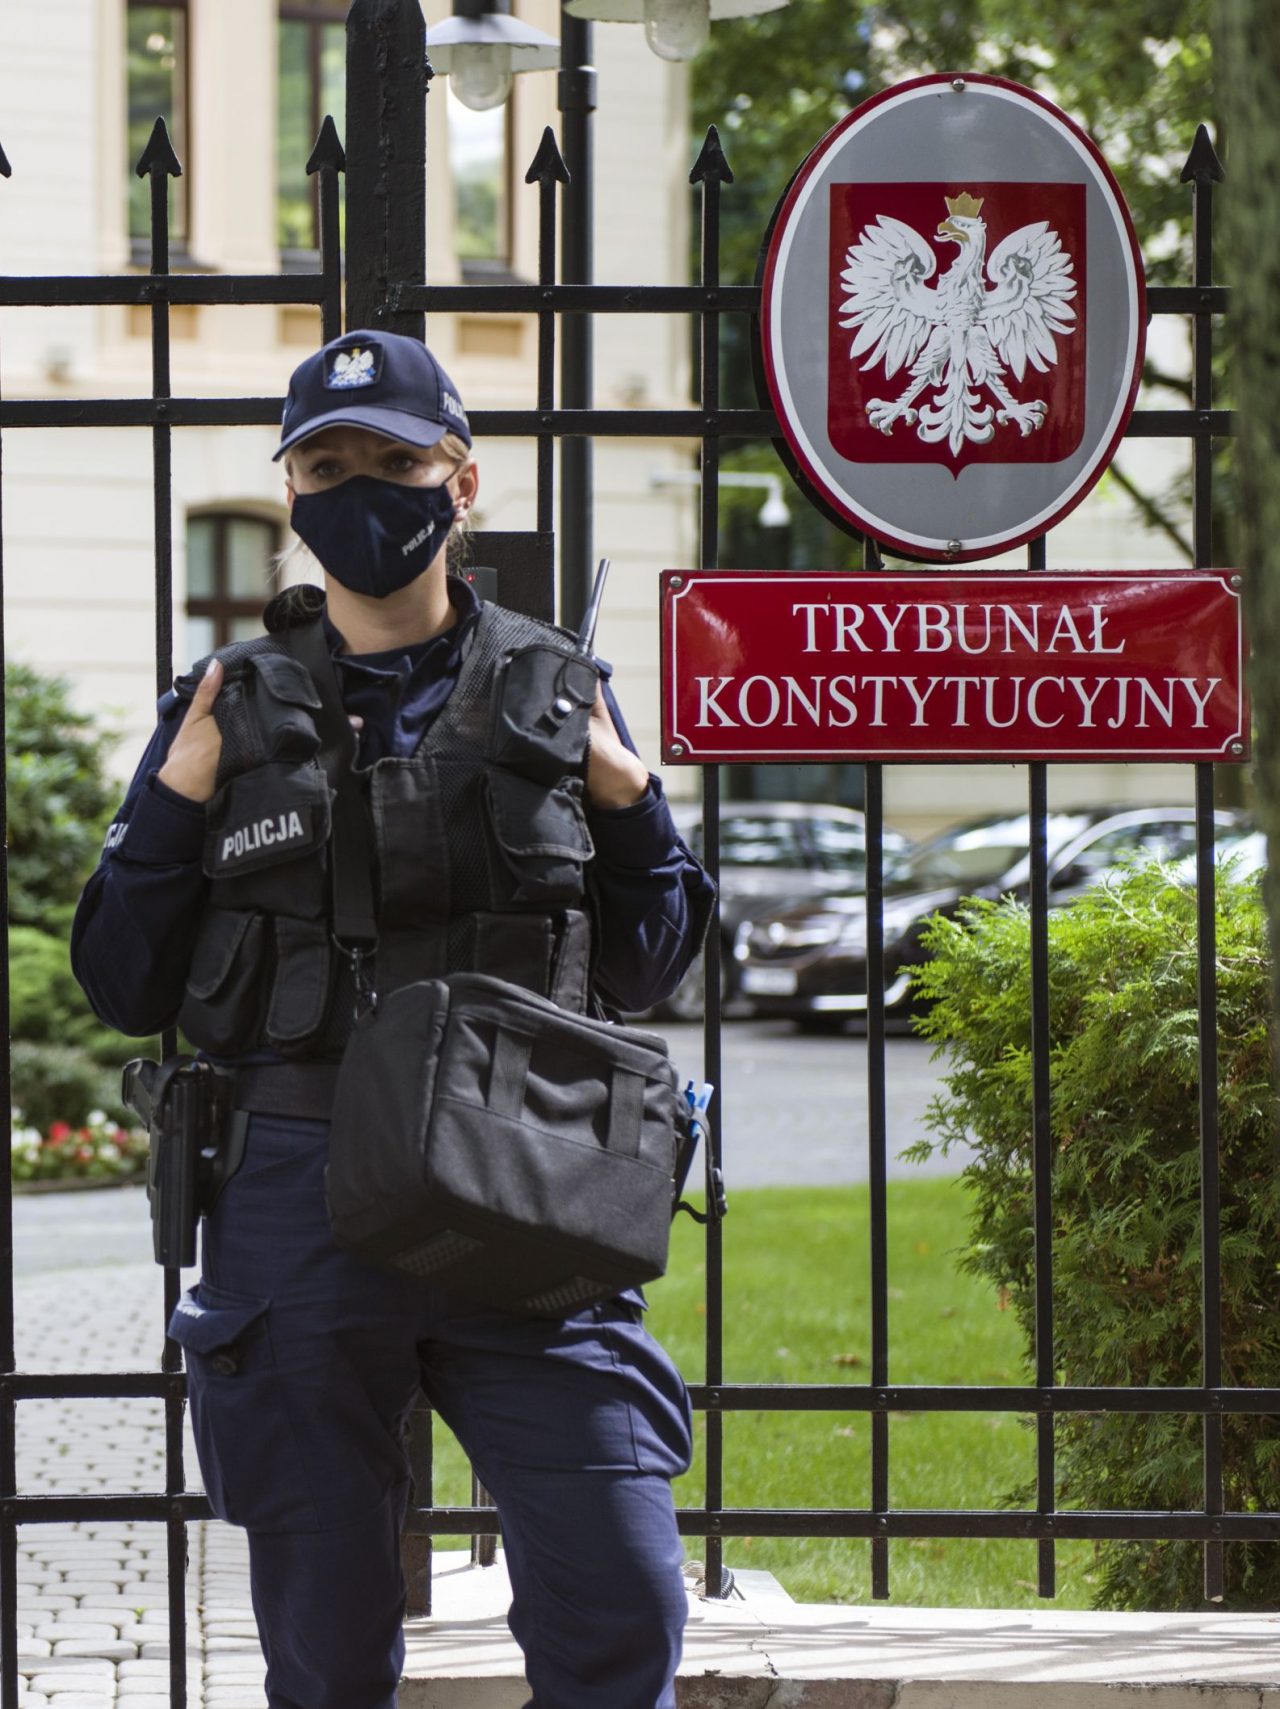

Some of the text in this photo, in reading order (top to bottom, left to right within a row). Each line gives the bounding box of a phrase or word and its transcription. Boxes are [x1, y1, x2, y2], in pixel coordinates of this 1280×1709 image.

[792, 603, 1126, 655] TRYBUNAŁ
[693, 674, 1222, 729] KONSTYTUCYJNY
[221, 811, 305, 862] POLICJA
